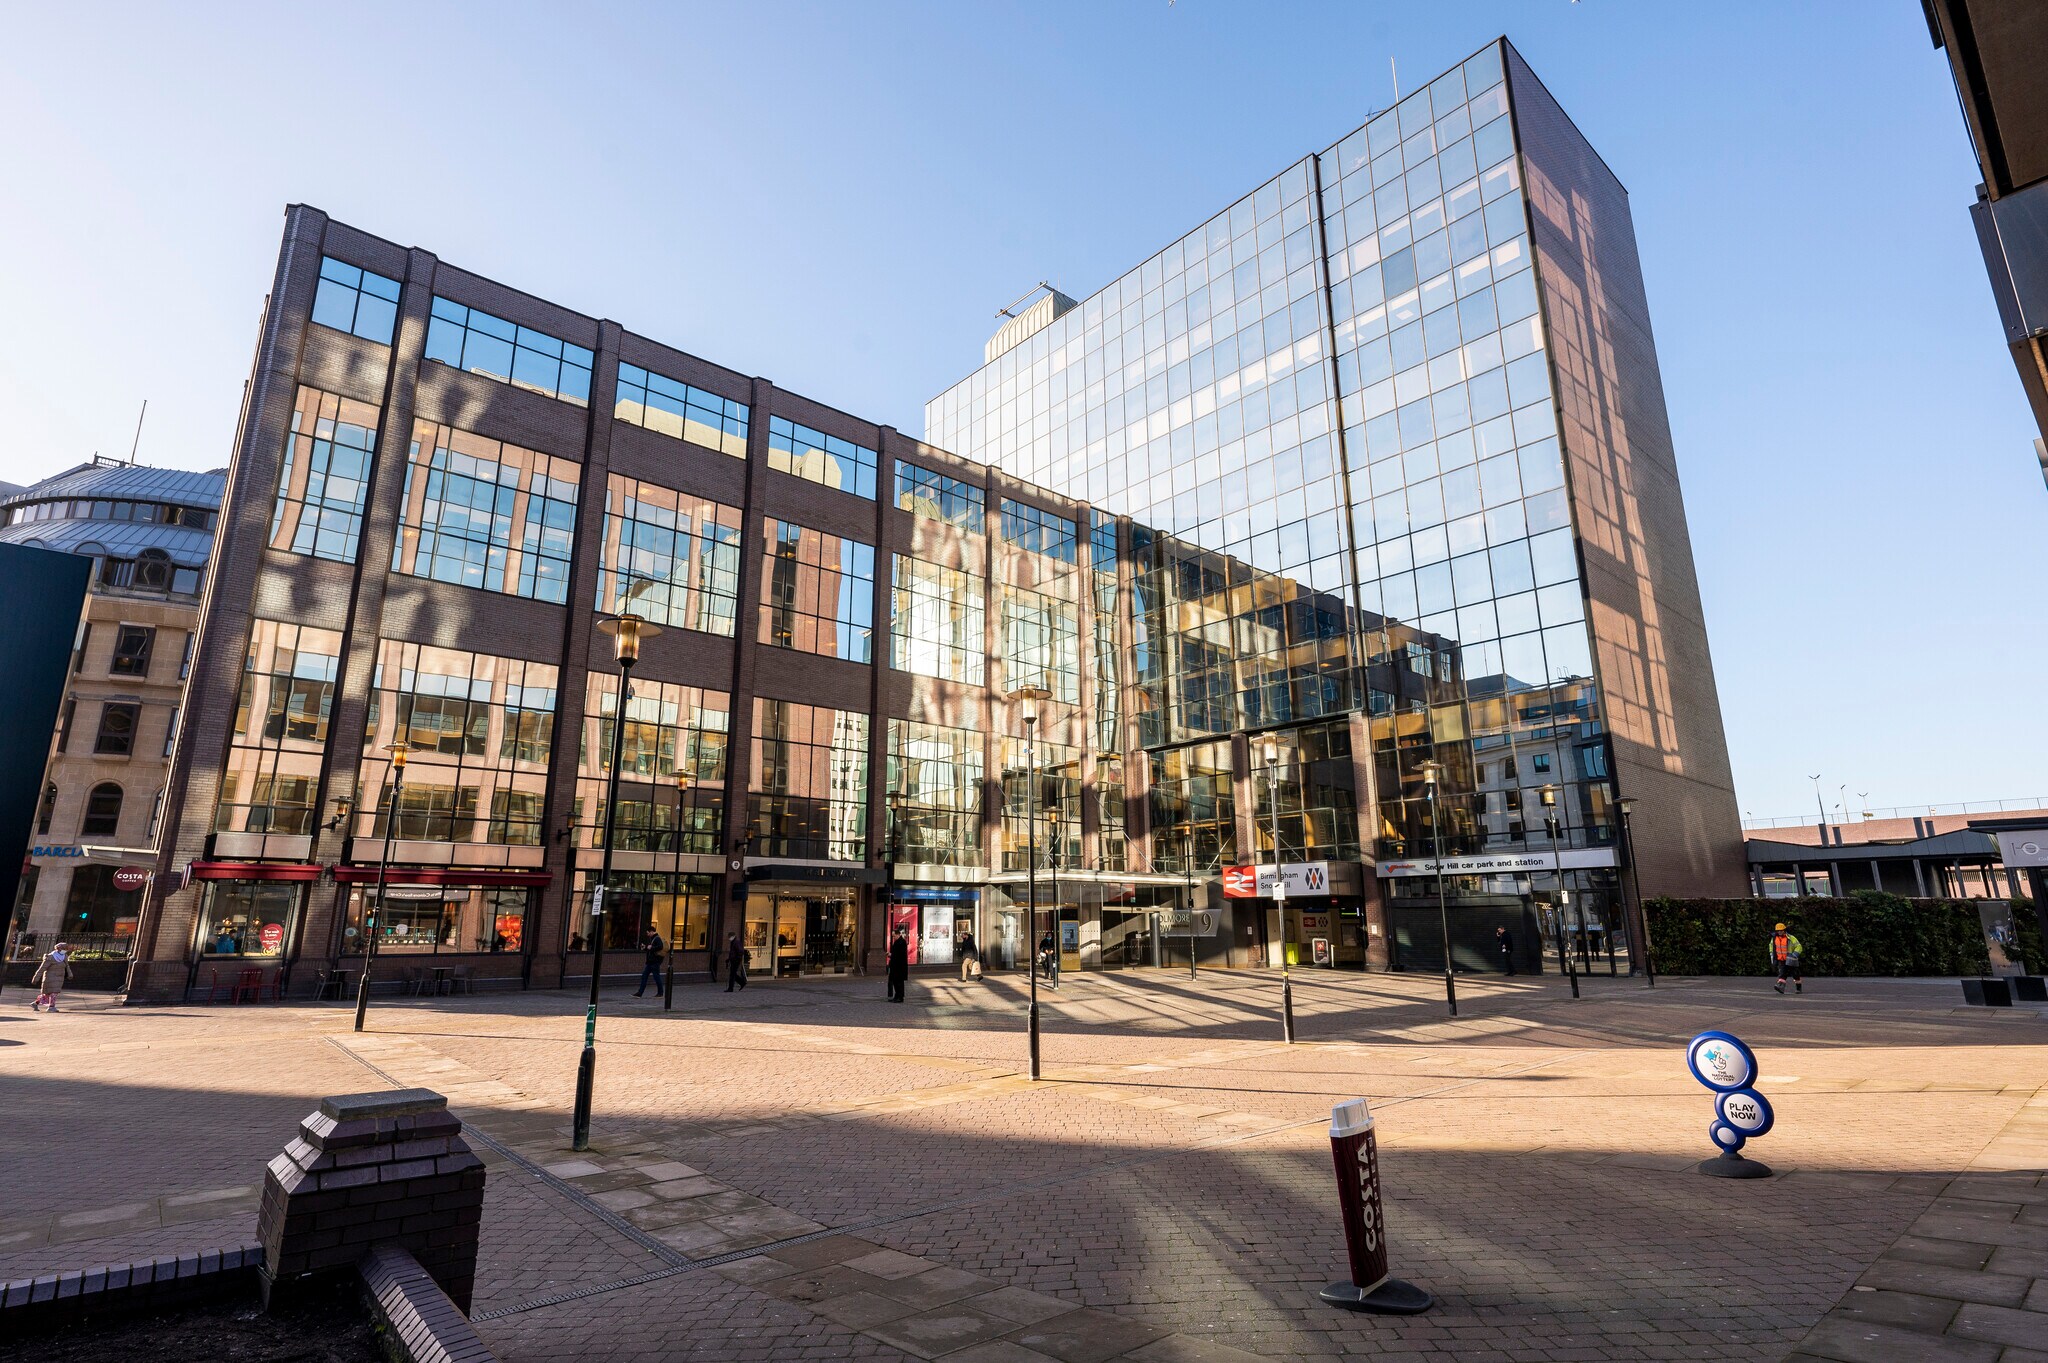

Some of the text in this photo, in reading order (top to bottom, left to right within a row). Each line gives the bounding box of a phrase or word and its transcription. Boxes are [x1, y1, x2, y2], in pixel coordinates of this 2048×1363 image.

[1476, 861, 1494, 869] park
[1260, 872, 1299, 881] Birmigham
[1260, 882, 1273, 890] Sno
[1202, 912, 1212, 933] 9
[1729, 1102, 1755, 1112] PLAY
[1730, 1111, 1756, 1120] NOW
[1357, 1142, 1377, 1252] COSTA
